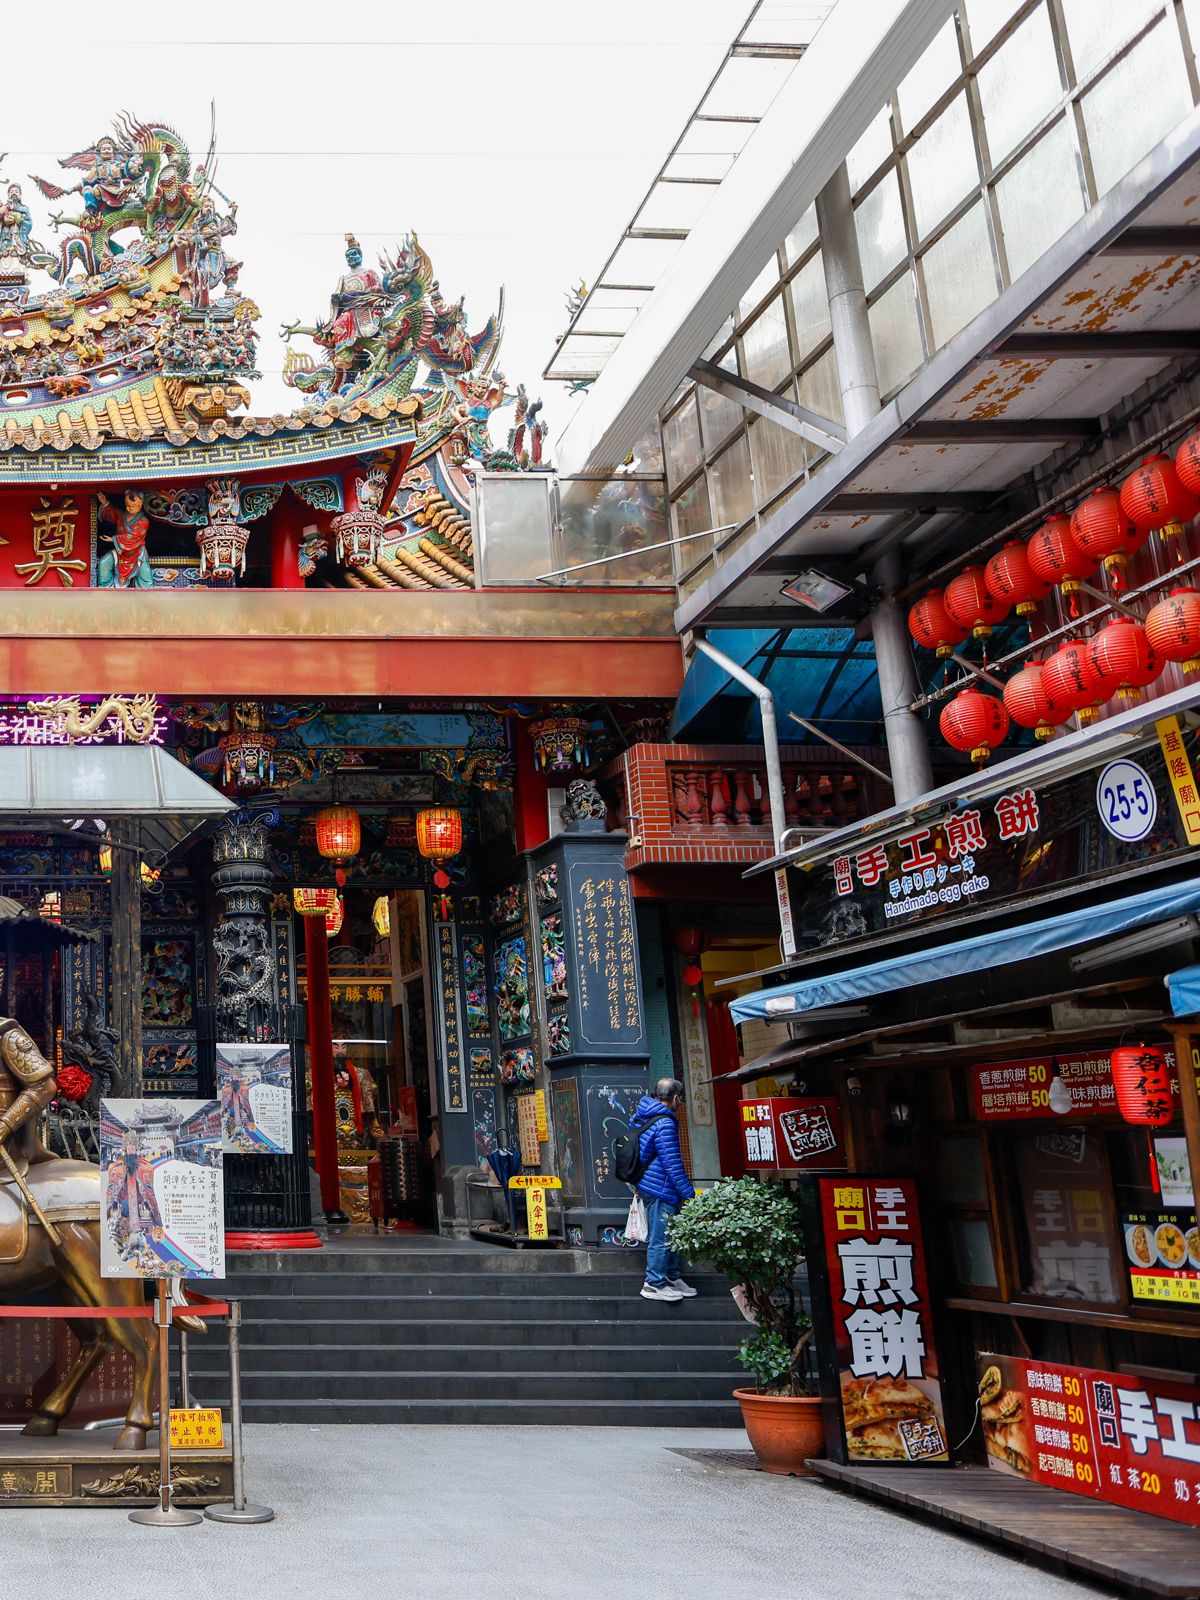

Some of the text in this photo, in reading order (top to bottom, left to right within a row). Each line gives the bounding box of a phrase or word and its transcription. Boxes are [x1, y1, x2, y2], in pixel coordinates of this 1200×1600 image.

[857, 789, 1038, 887] 手工煎餅
[834, 856, 853, 895] 廟口
[884, 875, 989, 918] Handmade egg cake
[1028, 1065, 1046, 1083] 50
[1031, 1089, 1049, 1107] 50
[745, 1127, 774, 1161] 煎餅
[791, 1128, 831, 1152] 煎餅
[532, 1190, 544, 1236] 雨傘架
[833, 1187, 866, 1231] 廟口
[874, 1187, 910, 1231] 手工
[838, 1238, 926, 1379] 煎餅
[1026, 1370, 1081, 1397] 原味煎餅 50
[1068, 1404, 1085, 1425] 50
[1093, 1381, 1120, 1448] 廟口
[1072, 1433, 1088, 1454] 50
[1038, 1452, 1093, 1483] 起司煎餅 60
[1109, 1463, 1161, 1495] 紅茶 20
